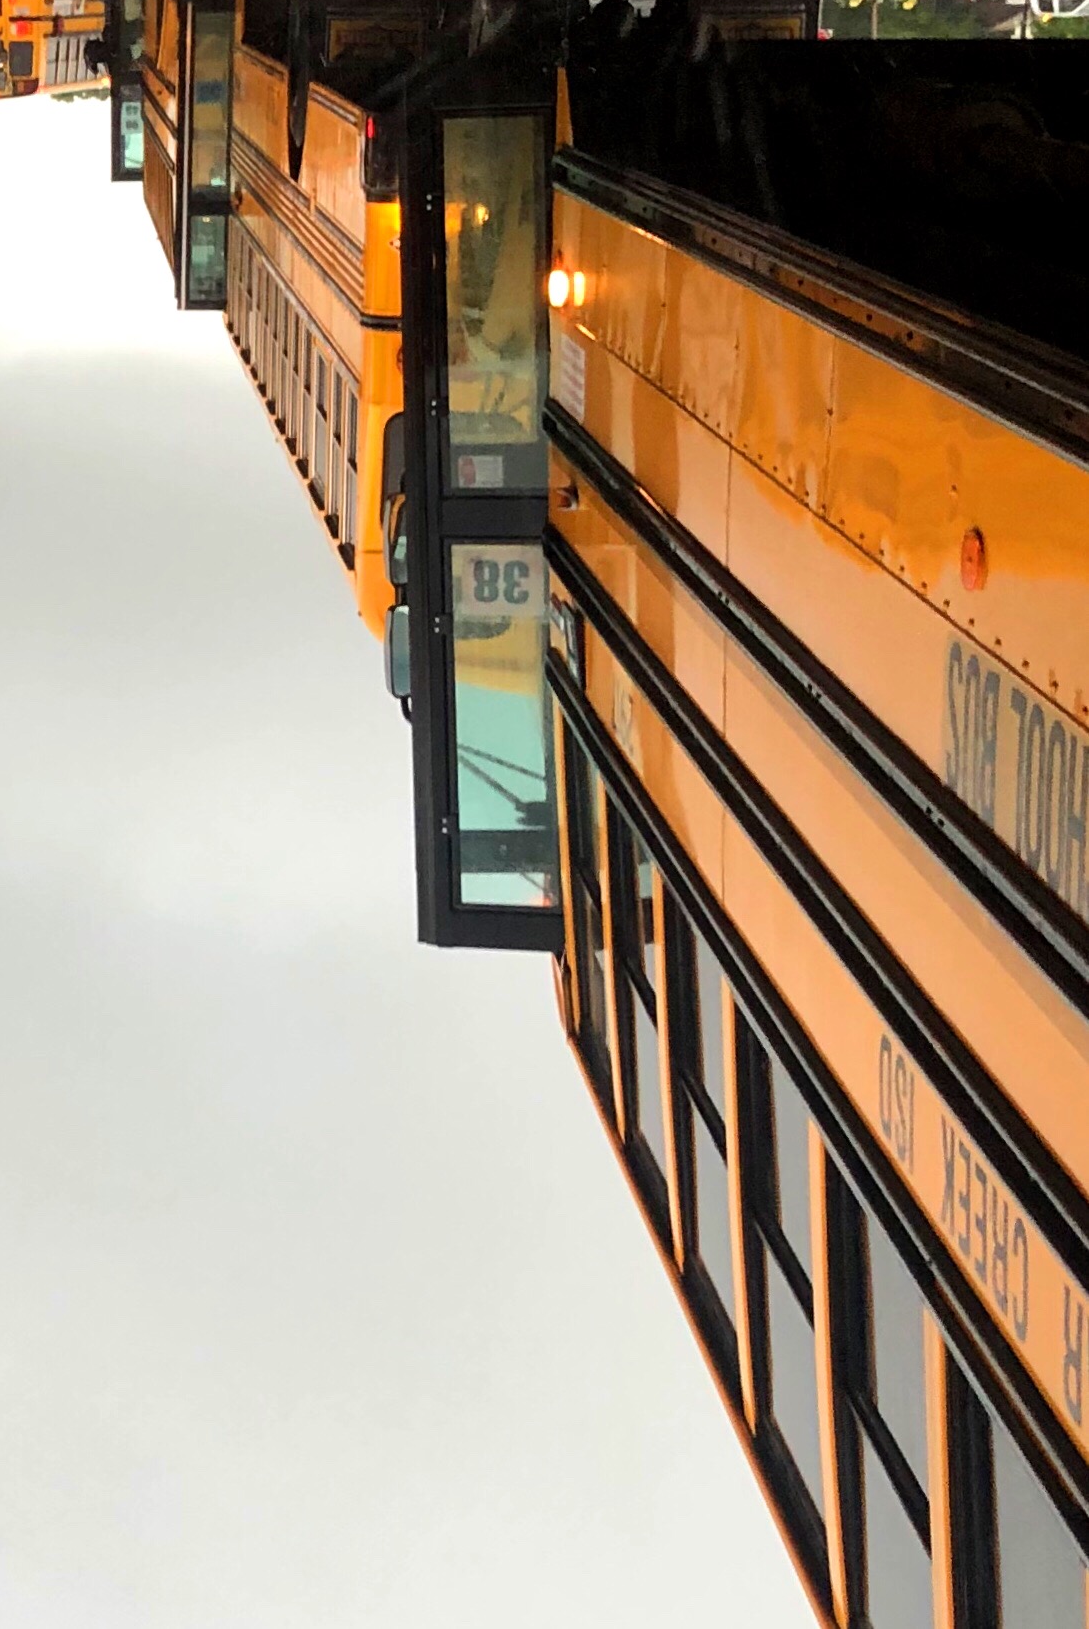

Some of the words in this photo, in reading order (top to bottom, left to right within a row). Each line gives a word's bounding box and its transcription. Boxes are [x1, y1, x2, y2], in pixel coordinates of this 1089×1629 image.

[472, 560, 530, 605] 38
[946, 642, 1000, 829] BUS
[878, 1033, 915, 1176] ISD
[940, 1114, 1029, 1345] CREEK
